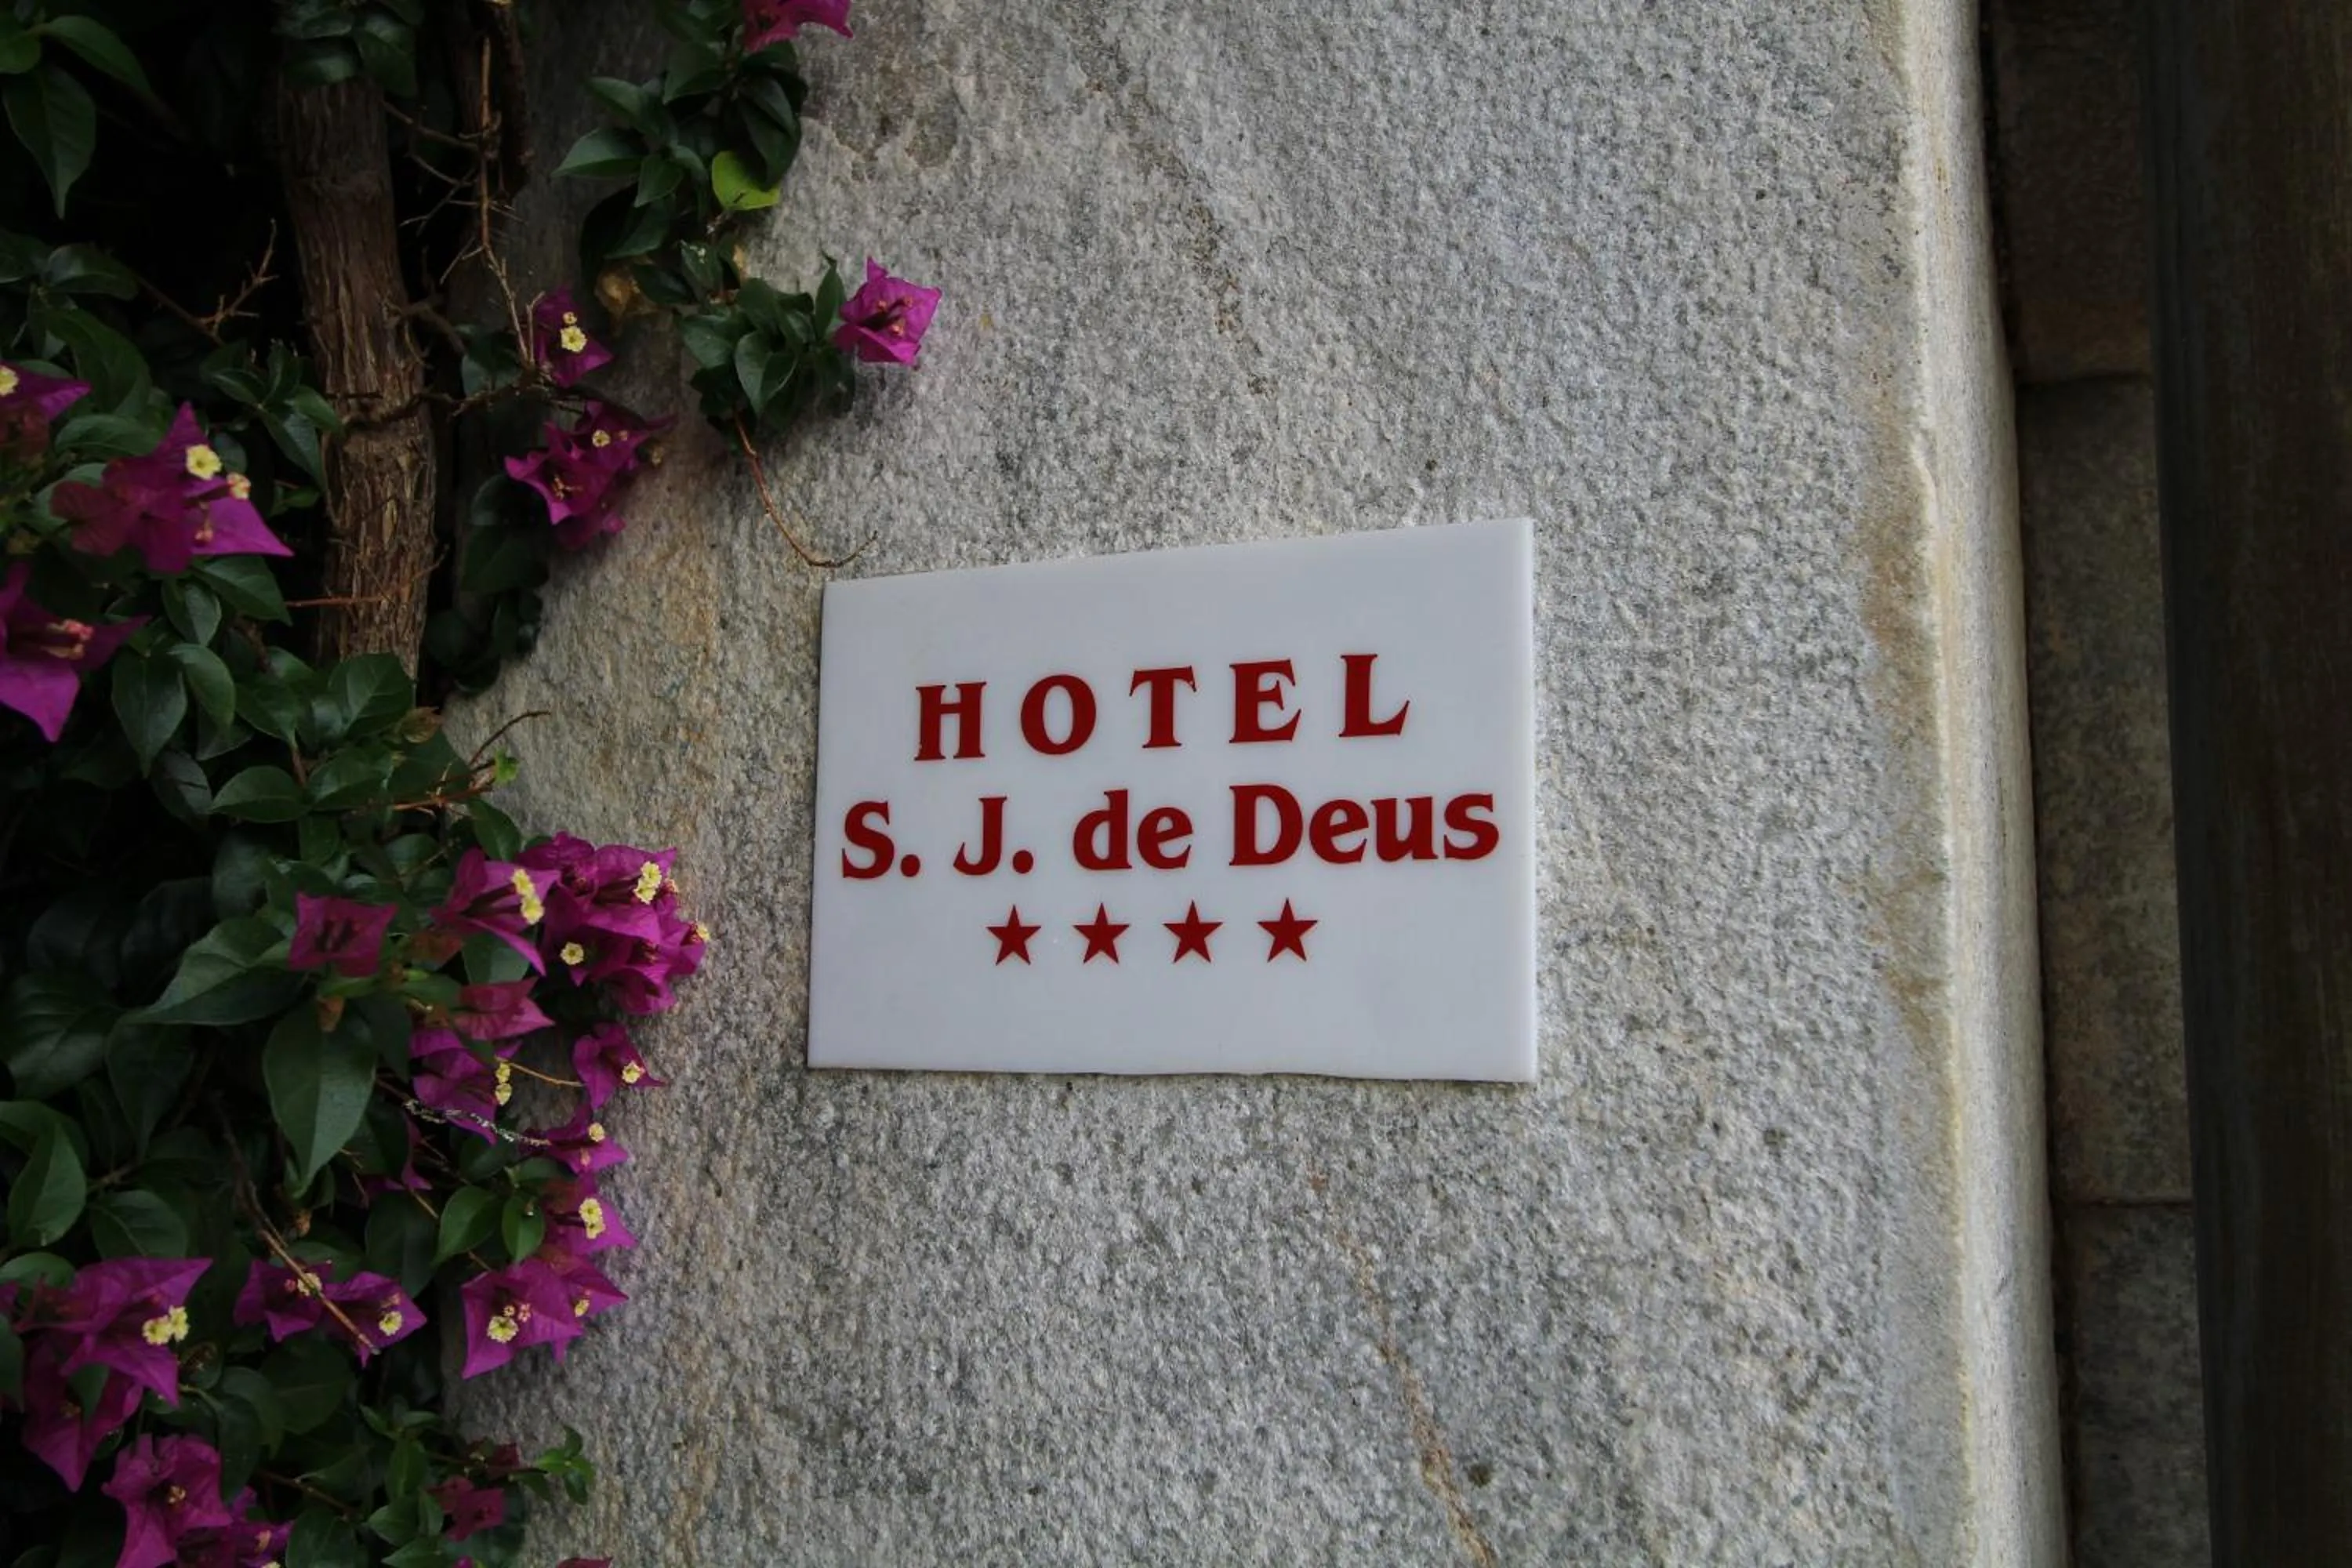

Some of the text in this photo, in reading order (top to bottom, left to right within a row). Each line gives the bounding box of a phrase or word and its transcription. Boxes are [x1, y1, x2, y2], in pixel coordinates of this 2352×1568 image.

[914, 653, 1410, 762] HOTEL
[841, 782, 1501, 880] S. J. de Deus
